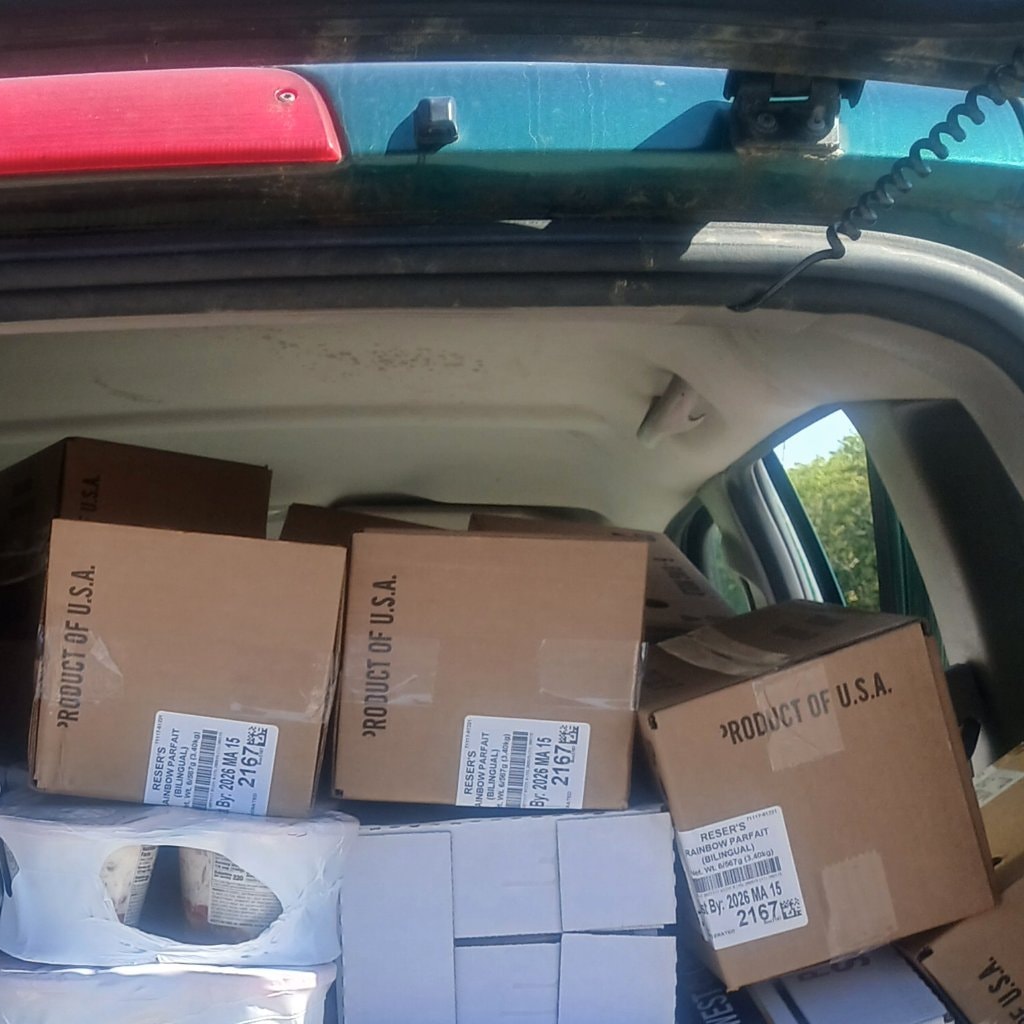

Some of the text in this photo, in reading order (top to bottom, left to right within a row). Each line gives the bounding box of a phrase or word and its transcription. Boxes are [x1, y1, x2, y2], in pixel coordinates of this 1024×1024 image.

[67, 565, 96, 616] U.S.A.
[370, 574, 398, 625] U.S.A.
[64, 620, 89, 645] OF
[368, 630, 393, 653] OF
[807, 689, 830, 718] OF
[836, 672, 893, 708] U.S.A.
[167, 728, 180, 767] PARFAIT
[222, 751, 238, 767] MA
[225, 737, 241, 748] 15
[478, 732, 490, 770] PARFAIT
[152, 746, 167, 791] RESER'S
[174, 746, 189, 798] (BILINGUAL)
[219, 767, 236, 791] 2026
[238, 746, 260, 788] 2167
[463, 750, 477, 795] RESER'S
[487, 749, 501, 800] (BILINGUAL)
[530, 737, 552, 807] By: 2026 MA 15
[551, 744, 572, 786] 2167
[216, 793, 235, 808] By:
[700, 821, 747, 842] RESER'S
[729, 827, 769, 846] PARFAIT
[701, 843, 755, 865] (BILINGUAL)
[708, 898, 725, 916] By:
[726, 890, 750, 909] 2026
[751, 885, 768, 902] MA
[769, 881, 782, 896] 15
[737, 900, 778, 927] 2167
[978, 956, 1023, 1008] U.S.A.
